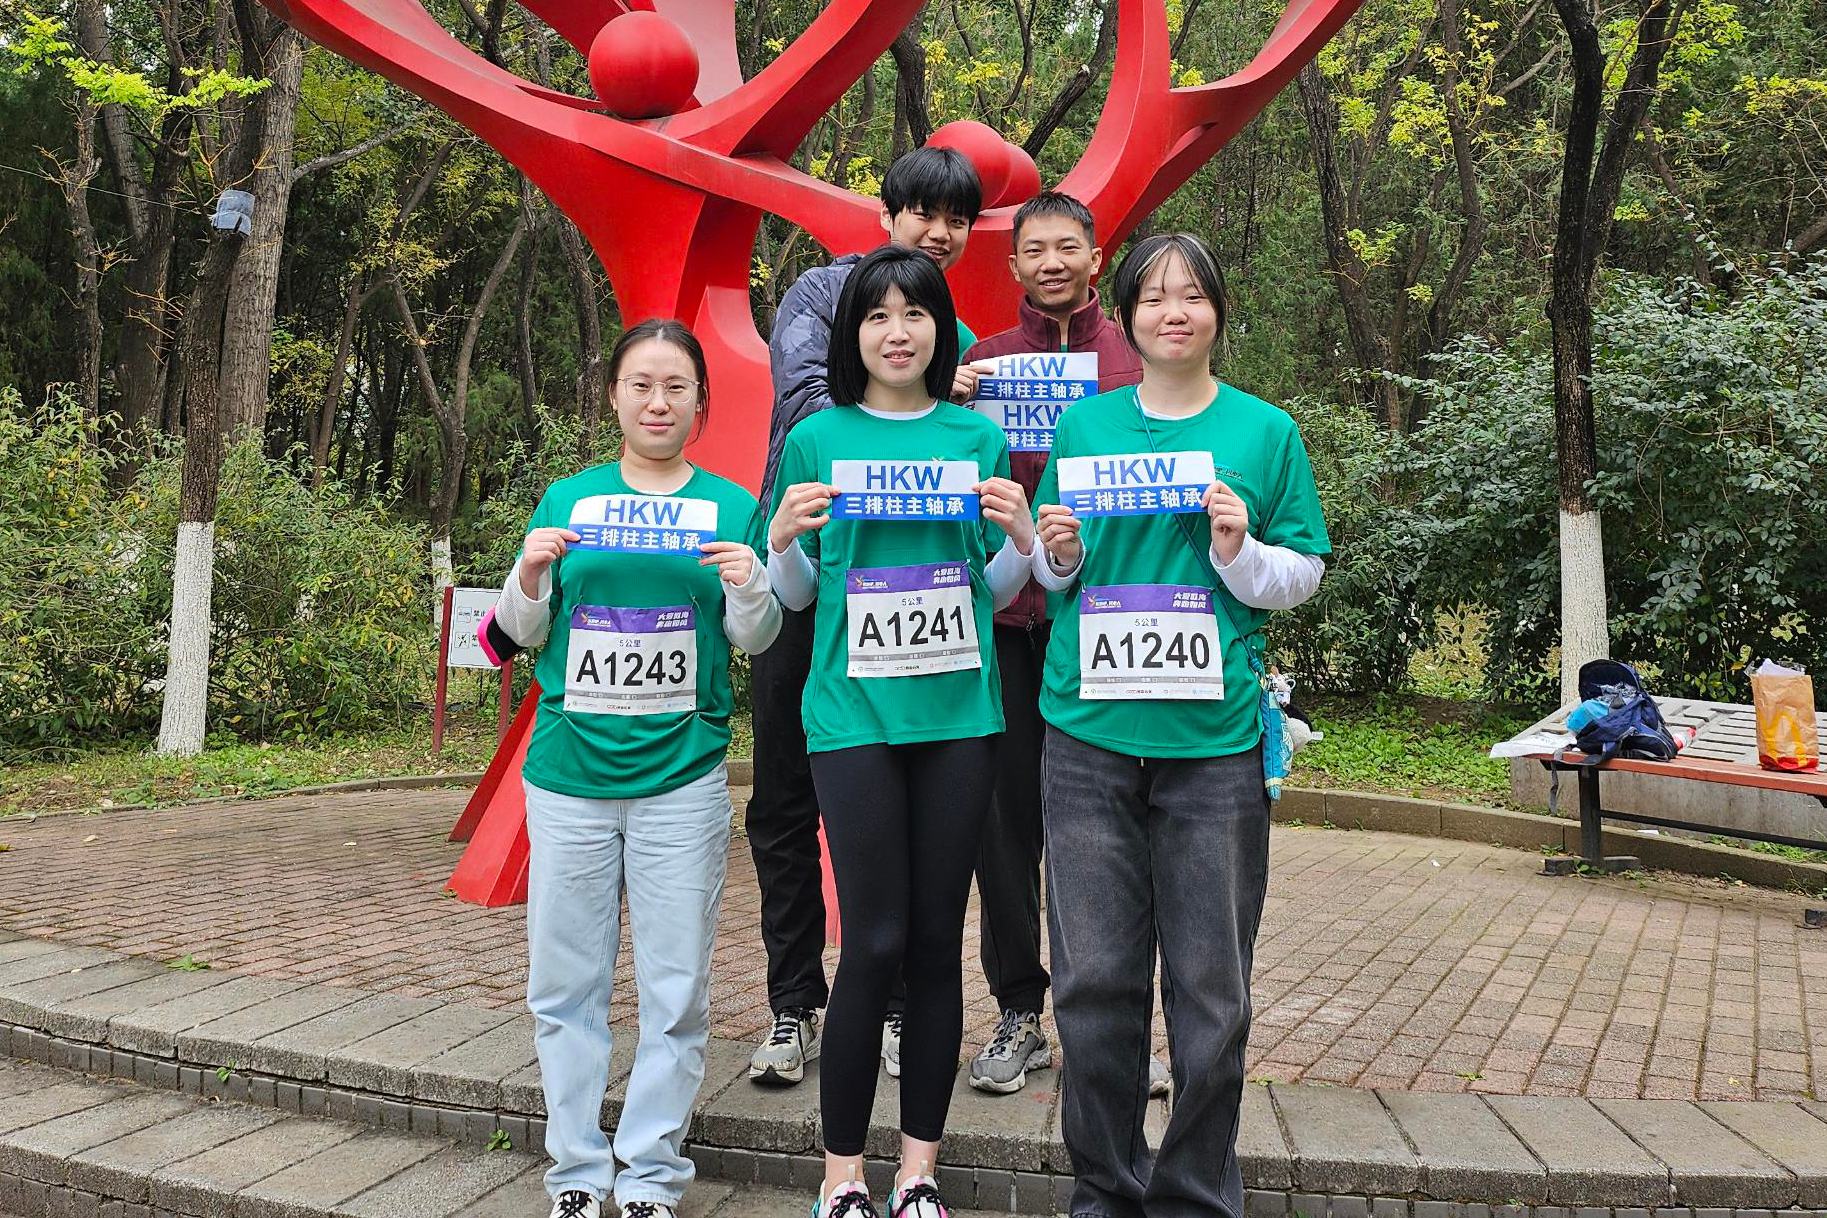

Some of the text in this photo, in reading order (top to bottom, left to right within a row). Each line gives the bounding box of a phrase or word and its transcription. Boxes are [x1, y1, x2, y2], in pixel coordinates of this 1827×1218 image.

[998, 356, 1067, 377] HKW
[980, 382, 1085, 399] 三排柱主轴承
[866, 464, 944, 491] HKW
[1093, 457, 1176, 486] HKW
[603, 499, 684, 526] HKW
[845, 496, 964, 515] 三排柱主轴承
[1074, 489, 1204, 512] 三排柱主轴承
[580, 528, 701, 550] 三排柱主轴承
[858, 605, 965, 648] A1241
[1091, 631, 1210, 670] A1240
[575, 649, 687, 687] A1243
